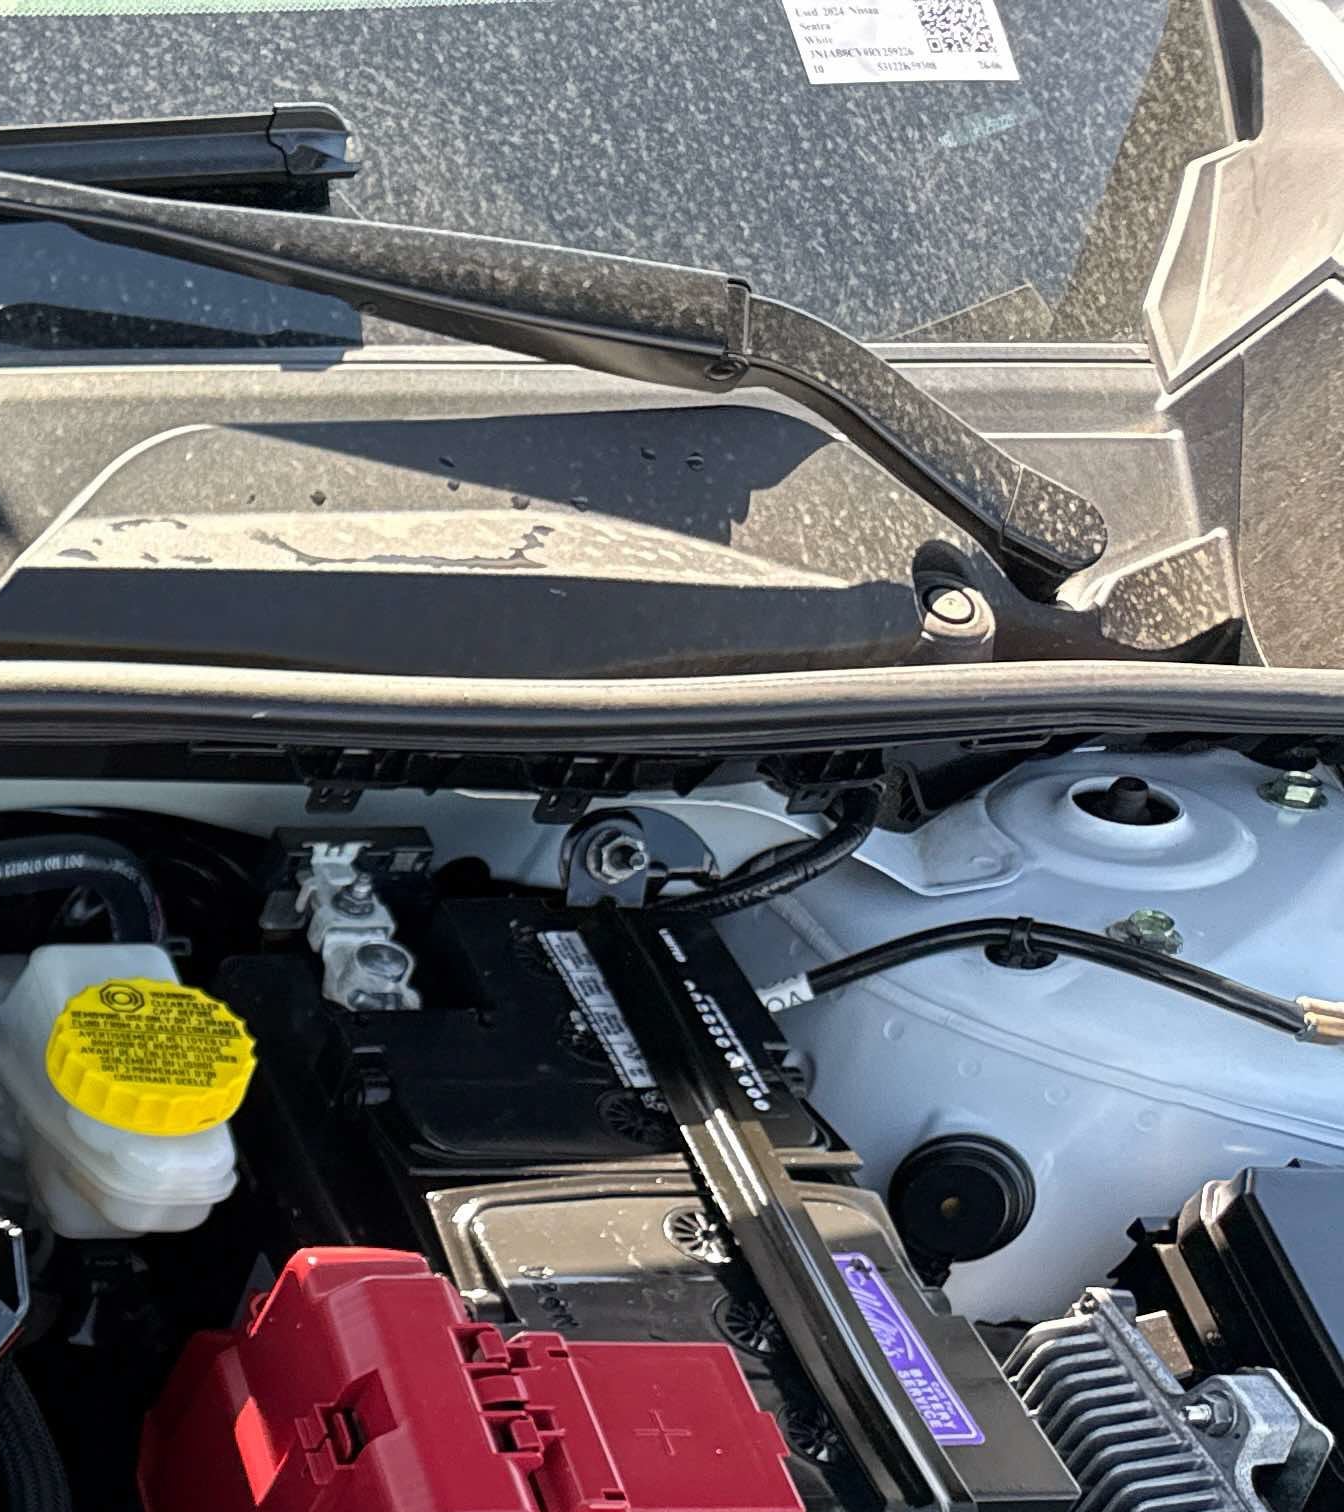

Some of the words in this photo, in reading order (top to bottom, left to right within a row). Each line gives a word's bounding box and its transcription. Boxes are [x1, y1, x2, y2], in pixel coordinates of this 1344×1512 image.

[824, 7, 844, 16] 2024
[850, 7, 879, 15] Nissan
[800, 22, 831, 31] Sentra
[805, 36, 833, 45] White
[897, 1370, 942, 1429] SERVICE
[908, 1368, 957, 1429] BATTERY
